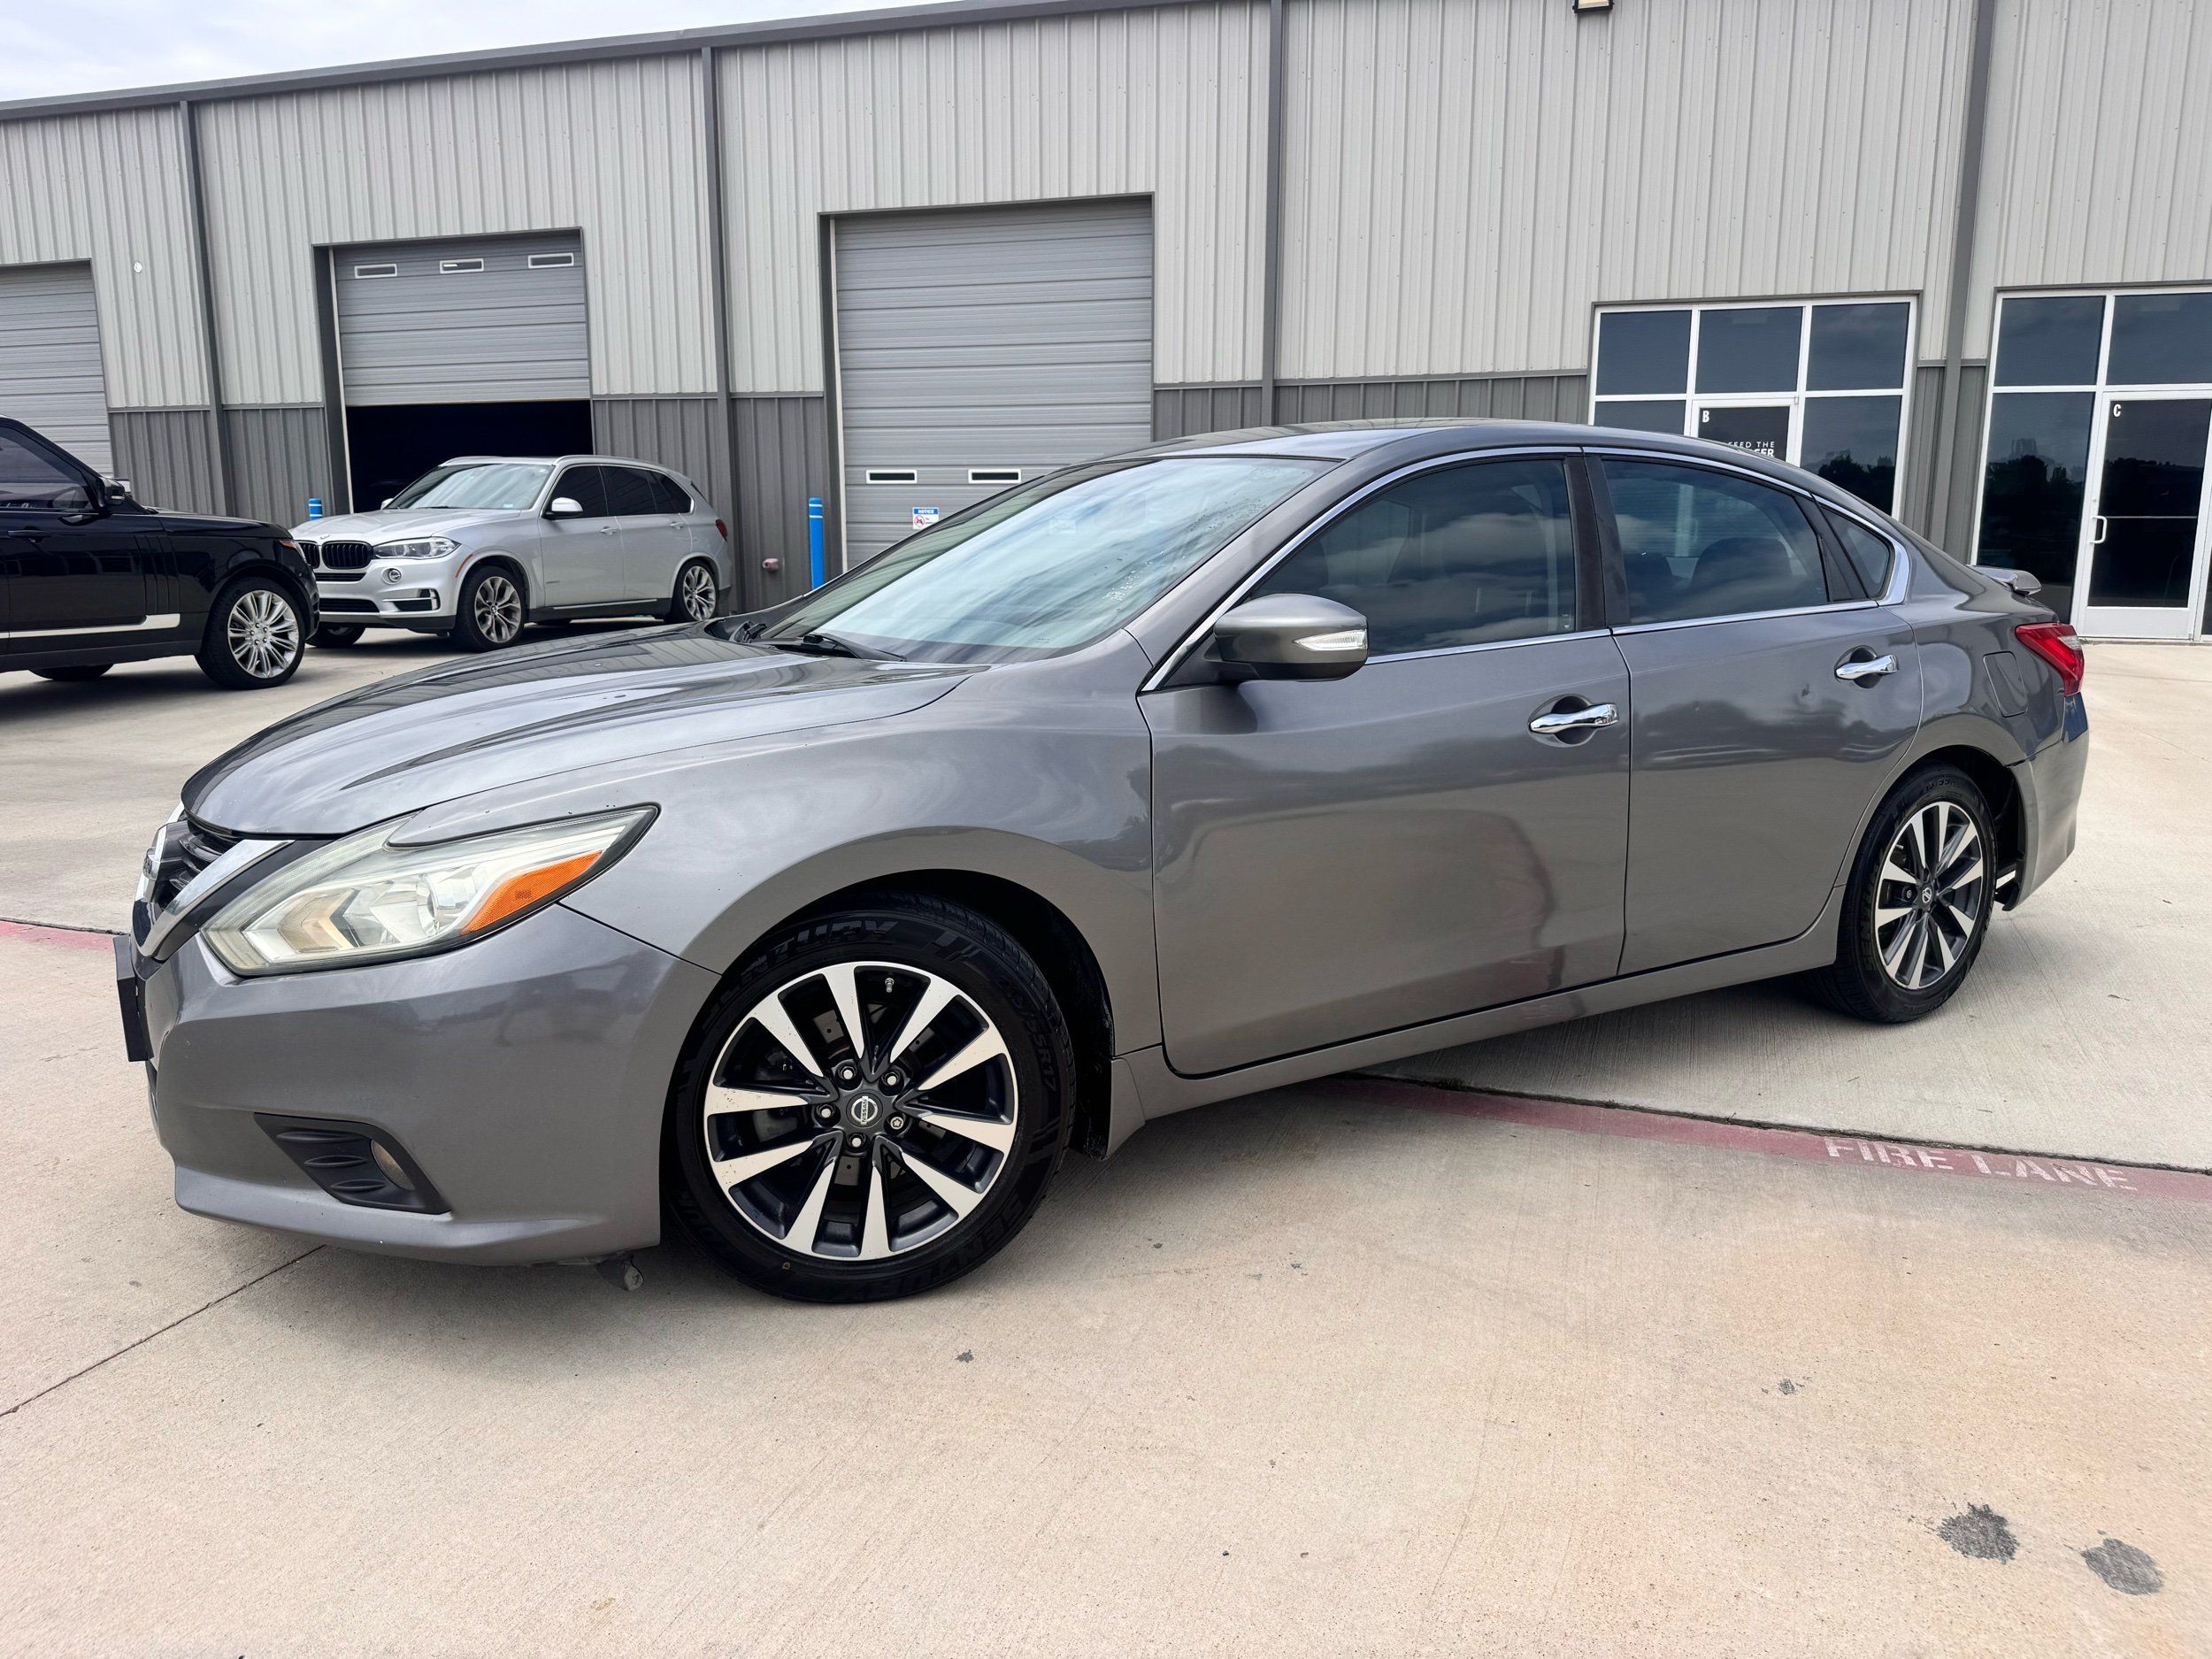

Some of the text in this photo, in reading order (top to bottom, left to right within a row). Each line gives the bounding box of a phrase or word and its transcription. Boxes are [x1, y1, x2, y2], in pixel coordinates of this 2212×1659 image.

[1701, 410, 1709, 423] B
[2113, 403, 2122, 418] C
[1824, 1135, 2138, 1192] FIRE LANE
